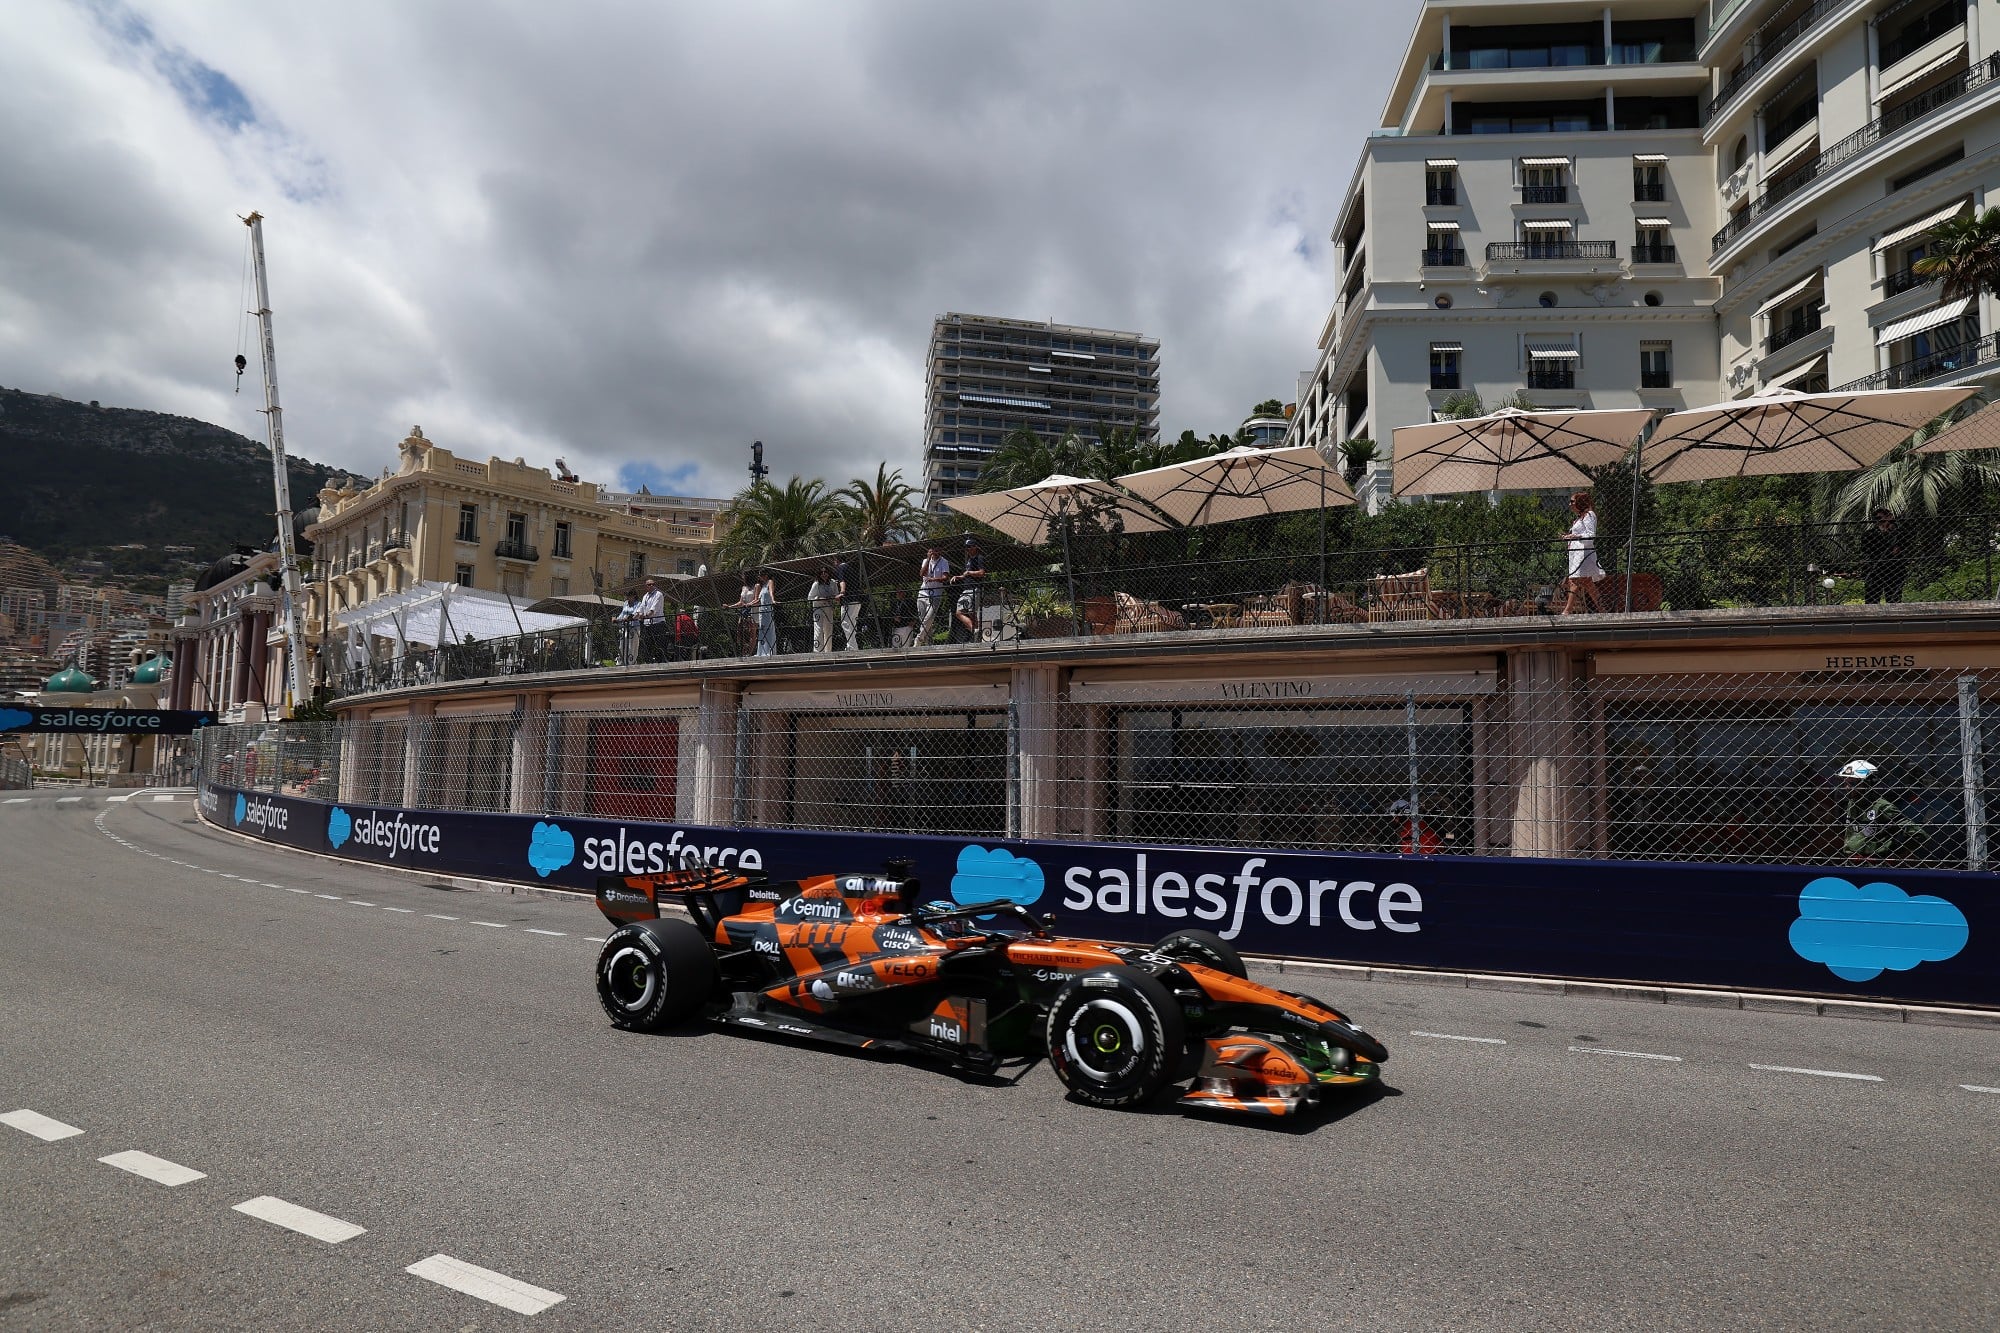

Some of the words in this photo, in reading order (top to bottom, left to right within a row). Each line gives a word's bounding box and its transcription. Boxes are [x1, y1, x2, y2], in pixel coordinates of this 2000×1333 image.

[1221, 680, 1312, 698] VALENTINO
[836, 693, 893, 707] VALENTINO
[39, 710, 161, 731] salesforce
[246, 796, 288, 834] salesforce
[354, 810, 441, 859] salesforce
[582, 827, 763, 875] salesforce
[616, 892, 649, 903] Dropbox
[749, 889, 782, 900] Deloitte.
[1063, 853, 1424, 941] salesforce
[793, 898, 842, 919] Gemini
[754, 940, 781, 955] DELL
[882, 940, 911, 950] cisco
[1012, 952, 1053, 962] RICHARD
[1055, 955, 1083, 964] MILLE
[884, 963, 927, 977] VELO
[930, 1018, 961, 1043] intel
